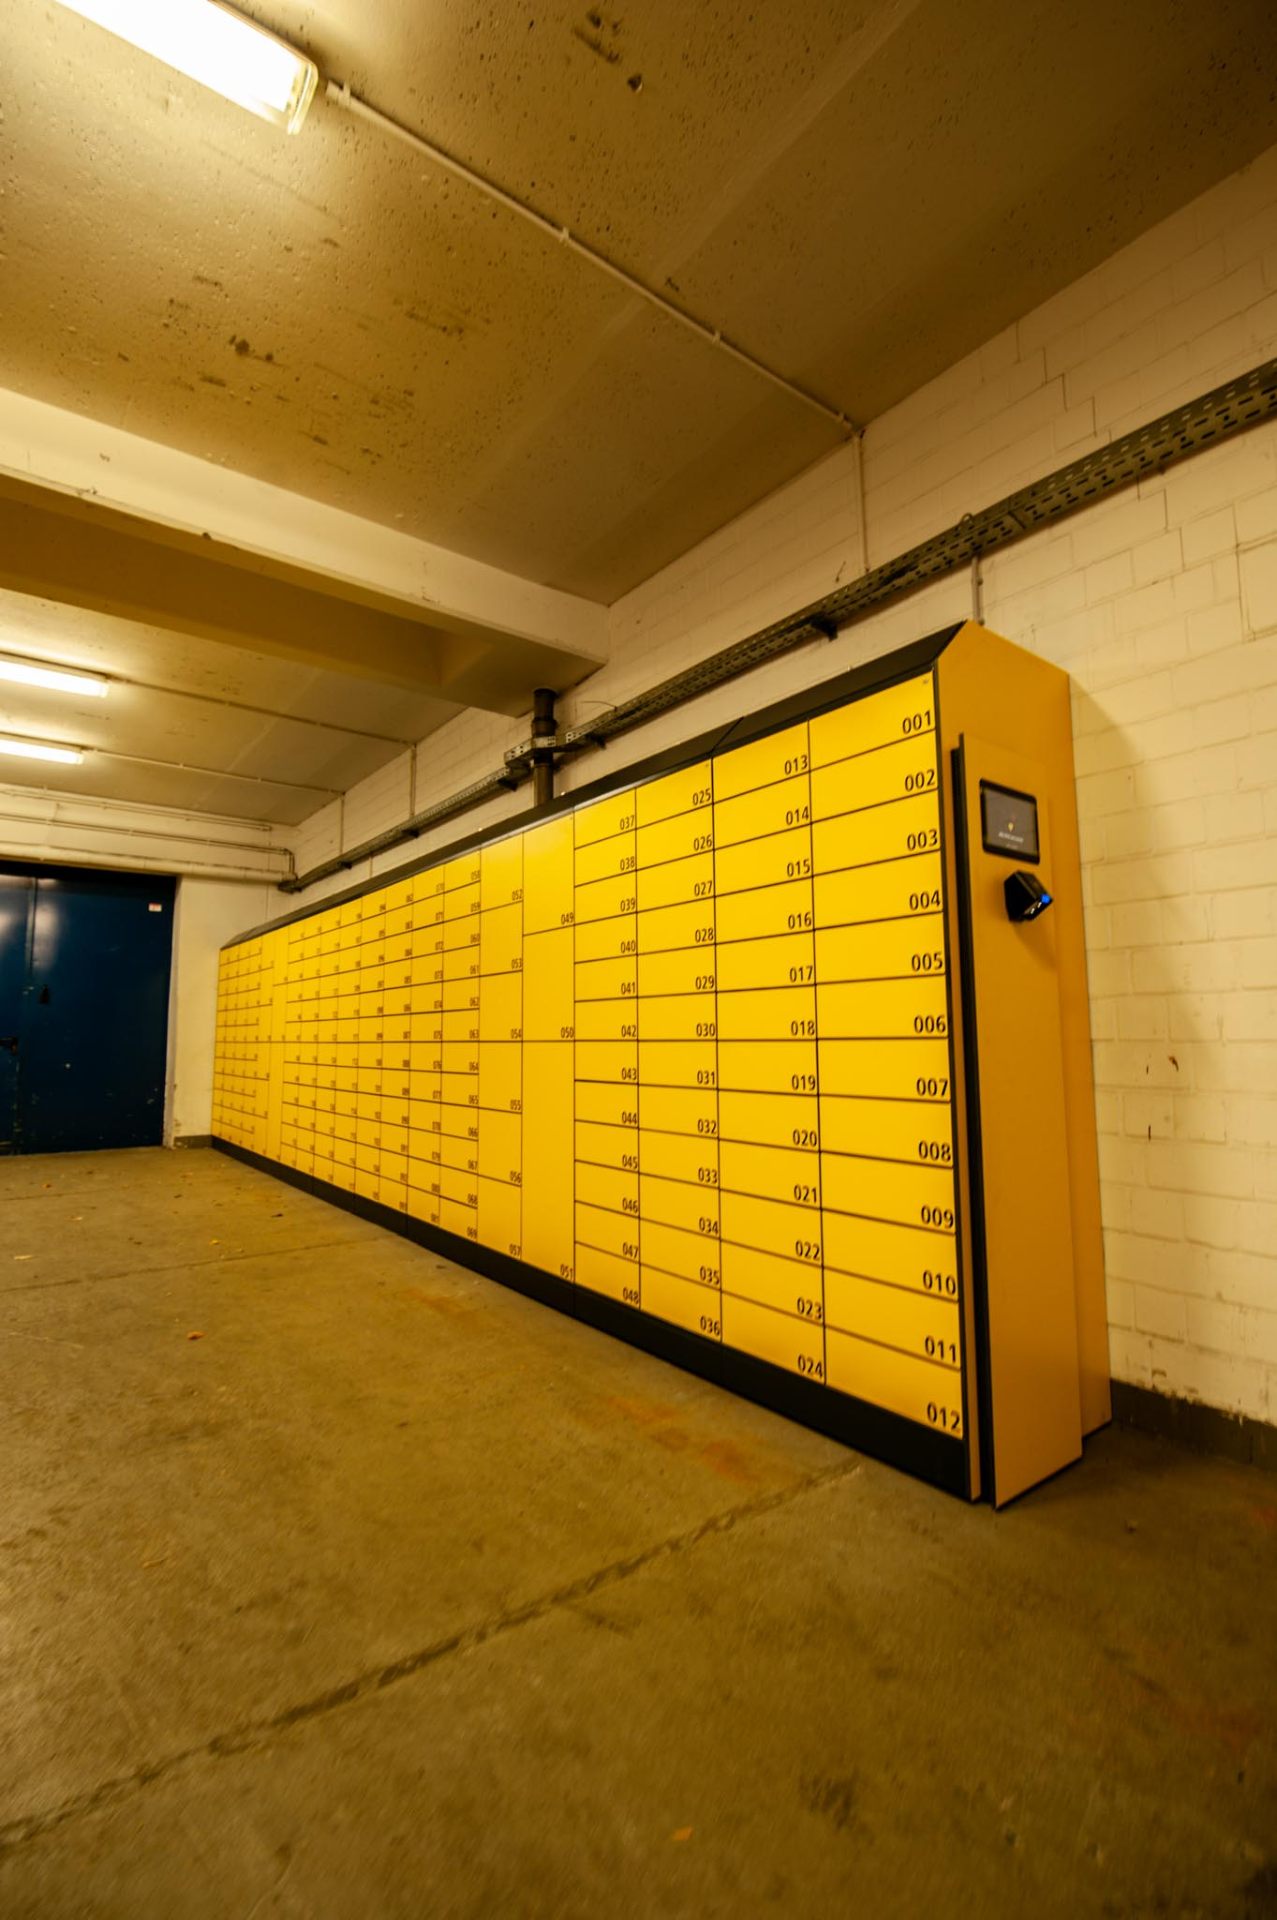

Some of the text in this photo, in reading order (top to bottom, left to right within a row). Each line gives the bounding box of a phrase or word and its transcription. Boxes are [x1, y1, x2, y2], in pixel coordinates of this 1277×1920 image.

[902, 711, 931, 734] 001
[785, 755, 808, 775] 013
[905, 770, 935, 791] 002
[693, 788, 711, 805] 025
[620, 815, 634, 830] 037
[786, 806, 809, 825] 014
[694, 834, 712, 851] 026
[907, 829, 938, 850] 003
[620, 856, 635, 870] 038
[787, 859, 810, 877] 015
[512, 889, 523, 900] 052
[694, 881, 712, 896] 027
[621, 898, 636, 912] 039
[909, 890, 940, 910] 004
[561, 912, 574, 925] 049
[788, 912, 812, 929] 016
[695, 928, 714, 942] 028
[621, 941, 636, 953] 040
[511, 958, 522, 969] 053
[911, 952, 943, 971] 005
[696, 975, 714, 990] 029
[789, 965, 813, 983] 017
[621, 982, 635, 995] 041
[561, 1027, 574, 1038] 050
[621, 1025, 636, 1037] 042
[696, 1023, 716, 1037] 030
[791, 1021, 815, 1036] 018
[914, 1015, 946, 1034] 006
[511, 1028, 522, 1039] 054
[622, 1068, 636, 1080] 043
[697, 1071, 715, 1085] 031
[792, 1074, 816, 1090] 019
[916, 1078, 948, 1096] 007
[510, 1100, 521, 1110] 055
[622, 1111, 637, 1124] 044
[698, 1119, 716, 1134] 032
[793, 1129, 817, 1147] 020
[919, 1141, 951, 1162] 008
[622, 1154, 637, 1169] 045
[510, 1171, 521, 1183] 056
[698, 1168, 717, 1184] 033
[794, 1184, 817, 1202] 021
[622, 1198, 638, 1213] 046
[699, 1217, 718, 1234] 034
[921, 1206, 953, 1228] 009
[509, 1244, 521, 1256] 057
[623, 1242, 638, 1259] 047
[796, 1240, 820, 1260] 022
[560, 1264, 573, 1279] 051
[700, 1266, 720, 1285] 035
[923, 1270, 956, 1295] 010
[623, 1287, 638, 1304] 048
[797, 1297, 822, 1320] 023
[700, 1316, 720, 1336] 036
[925, 1336, 956, 1363] 011
[798, 1355, 823, 1378] 024
[927, 1402, 960, 1433] 012
